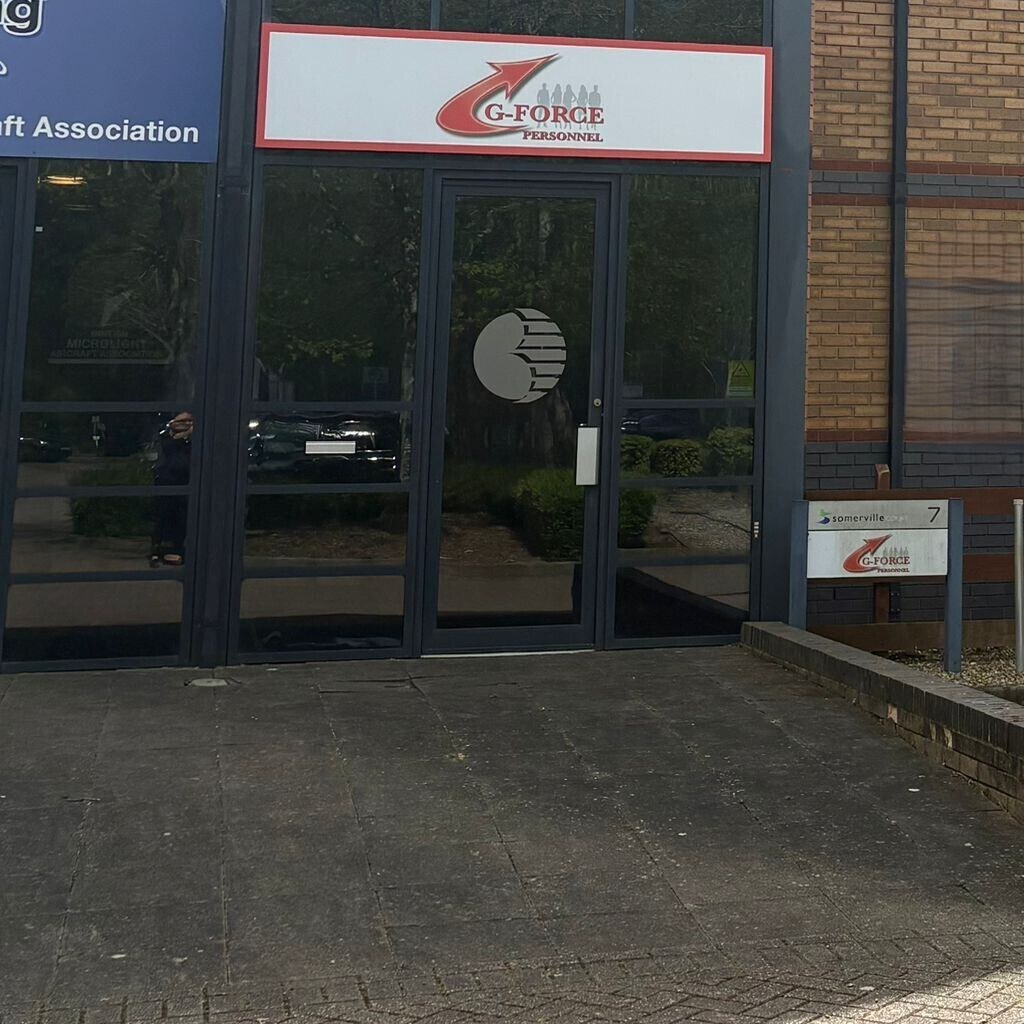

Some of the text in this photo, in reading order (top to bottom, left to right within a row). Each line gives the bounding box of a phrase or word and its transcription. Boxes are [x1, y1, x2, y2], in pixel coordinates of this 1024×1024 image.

[484, 103, 604, 125] G-FORCE
[0, 115, 199, 143] ft Association
[522, 130, 604, 142] PERSONNEL
[832, 513, 885, 523] somerville
[927, 506, 941, 523] 7
[862, 556, 911, 566] G-FORCE
